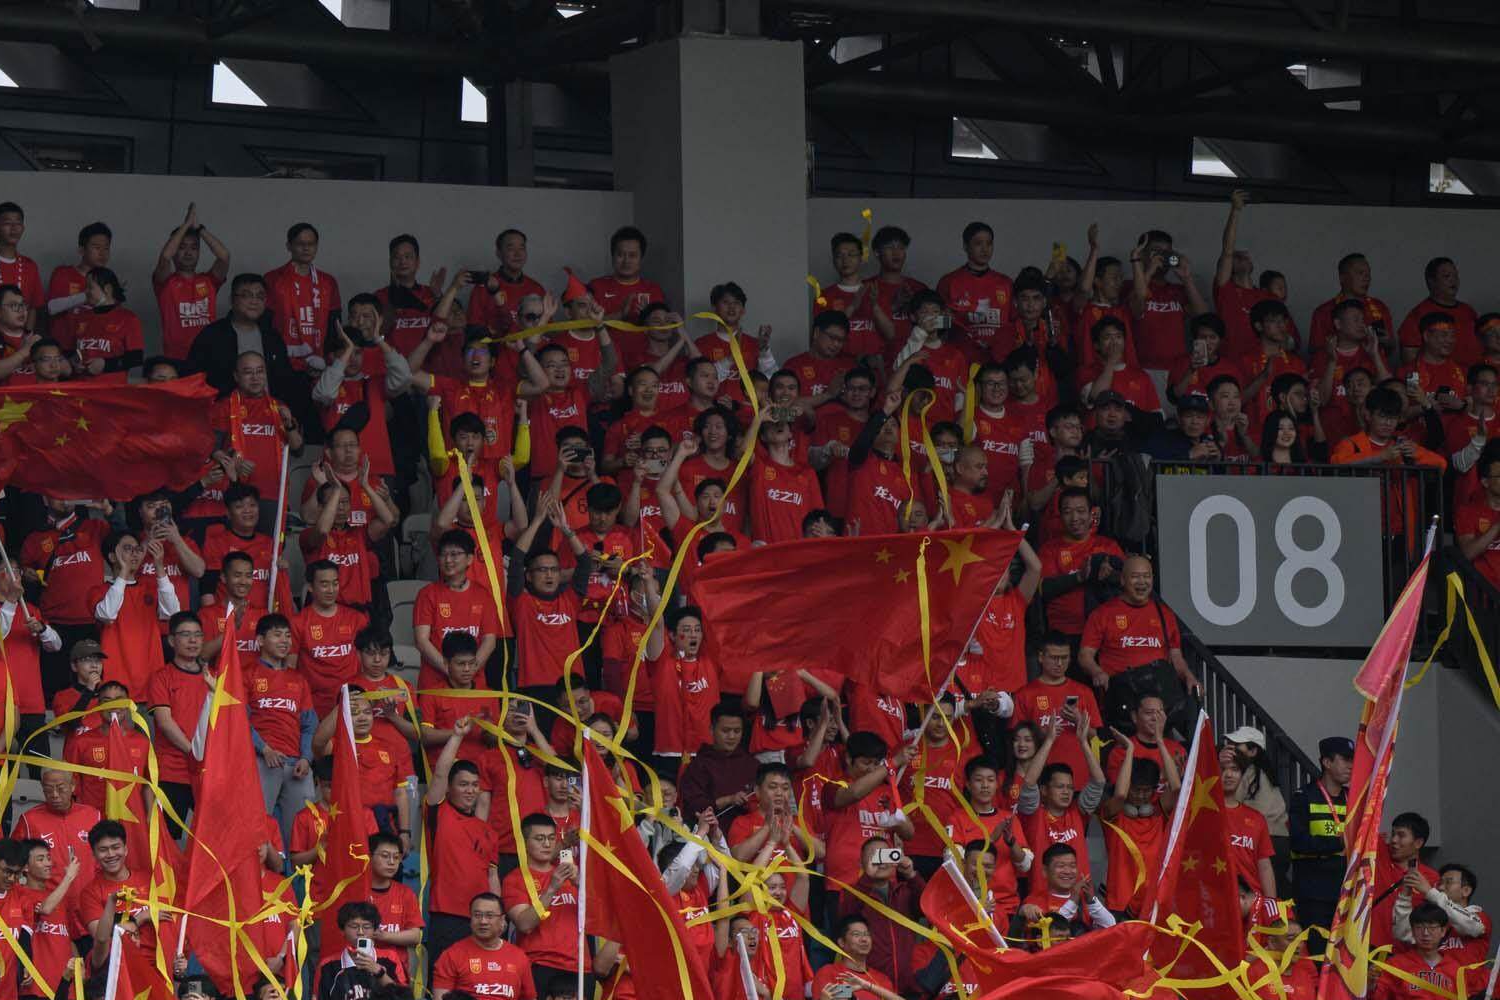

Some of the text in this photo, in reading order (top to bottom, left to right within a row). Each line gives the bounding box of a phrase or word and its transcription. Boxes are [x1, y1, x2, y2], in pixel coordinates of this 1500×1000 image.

[933, 375, 952, 390] 之队
[982, 440, 1020, 456] 龙之队
[202, 489, 223, 501] 之队
[328, 553, 359, 567] 龙之队
[1189, 494, 1345, 627] 08
[142, 561, 181, 577] 龙队
[251, 569, 271, 582] 之队
[237, 639, 261, 651] 之队
[1120, 636, 1161, 648] 龙之队
[312, 644, 352, 657] 龙之队
[258, 697, 297, 712] 龙之队
[910, 776, 952, 790] 之队
[1231, 834, 1253, 849] 之队
[551, 893, 576, 905] 之队
[35, 921, 69, 937] 龙之队
[379, 923, 400, 933] 之队
[778, 926, 799, 938] 之队
[1439, 936, 1464, 950] 之队
[475, 983, 514, 998] 龙之队
